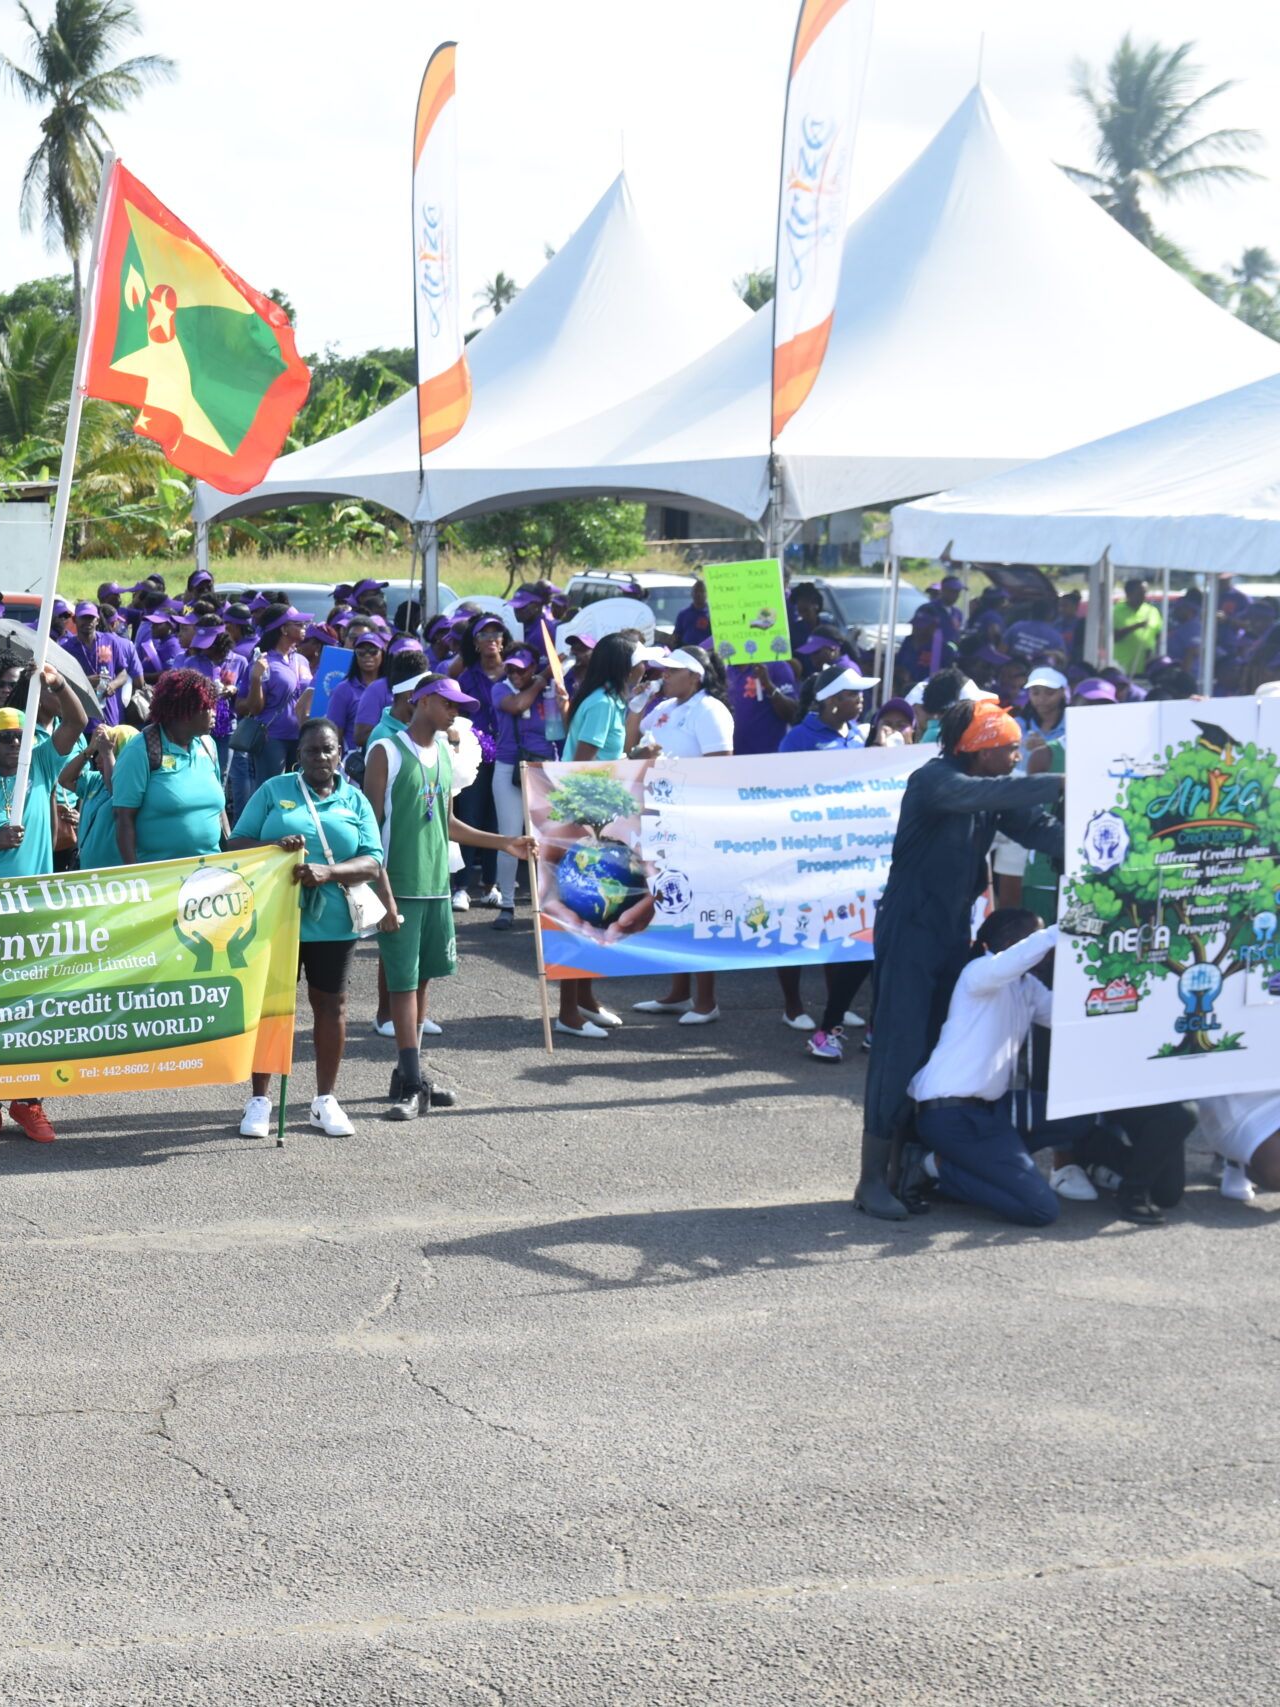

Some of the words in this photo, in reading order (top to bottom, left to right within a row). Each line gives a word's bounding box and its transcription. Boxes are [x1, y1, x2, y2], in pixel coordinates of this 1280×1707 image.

[738, 784, 811, 800] Different
[814, 779, 865, 796] Credit
[867, 777, 908, 791] Unio
[1147, 768, 1261, 819] Ariza
[790, 809, 823, 822] One
[826, 805, 891, 820] Mission.
[781, 834, 842, 852] Helping
[1202, 847, 1236, 860] Credit
[797, 855, 876, 873] Prosperity
[37, 874, 153, 911] Union
[183, 892, 241, 921] GCCU
[2, 965, 49, 982] Credit
[53, 957, 94, 977] Union
[98, 952, 157, 972] Limited
[40, 993, 112, 1018] Credit
[117, 988, 184, 1011] Union
[190, 984, 231, 1008] Day
[2, 1023, 128, 1050] PROSPEROUS
[132, 1016, 204, 1038] WORLD
[80, 1067, 100, 1079] Tel:
[102, 1063, 149, 1076] 442-8602
[158, 1058, 204, 1072] 442-0095
